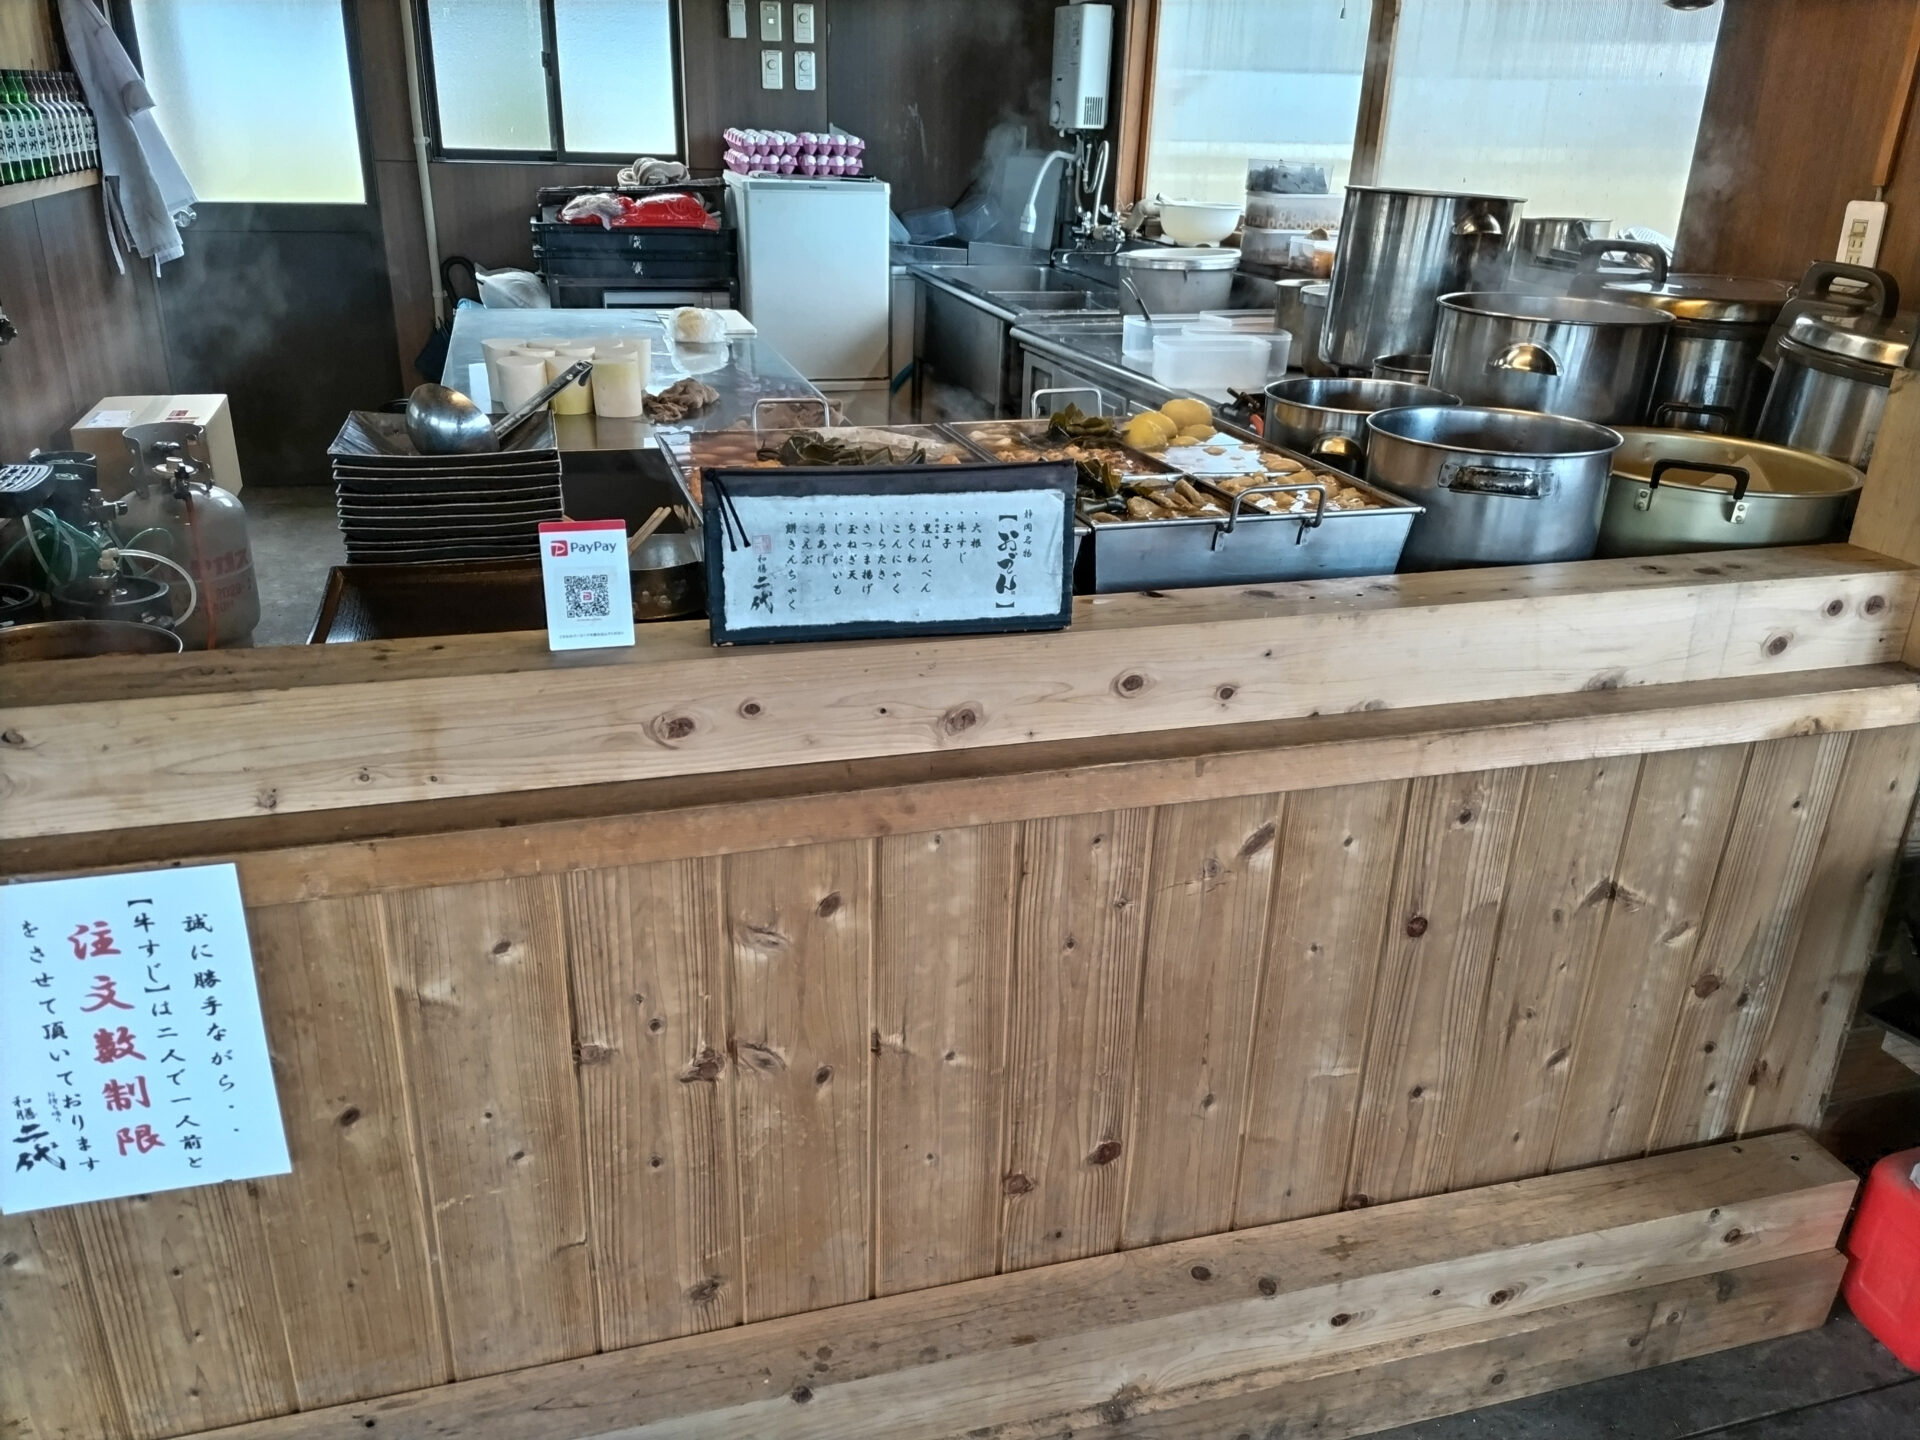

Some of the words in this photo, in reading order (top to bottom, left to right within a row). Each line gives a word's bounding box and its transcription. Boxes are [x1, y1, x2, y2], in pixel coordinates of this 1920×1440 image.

[570, 541, 617, 553] PayPay
[1022, 508, 1033, 559] 静岡名物
[22, 920, 100, 1172] をさせて頂いております
[127, 897, 204, 1169] 【牛すじ】は二人で一人前と
